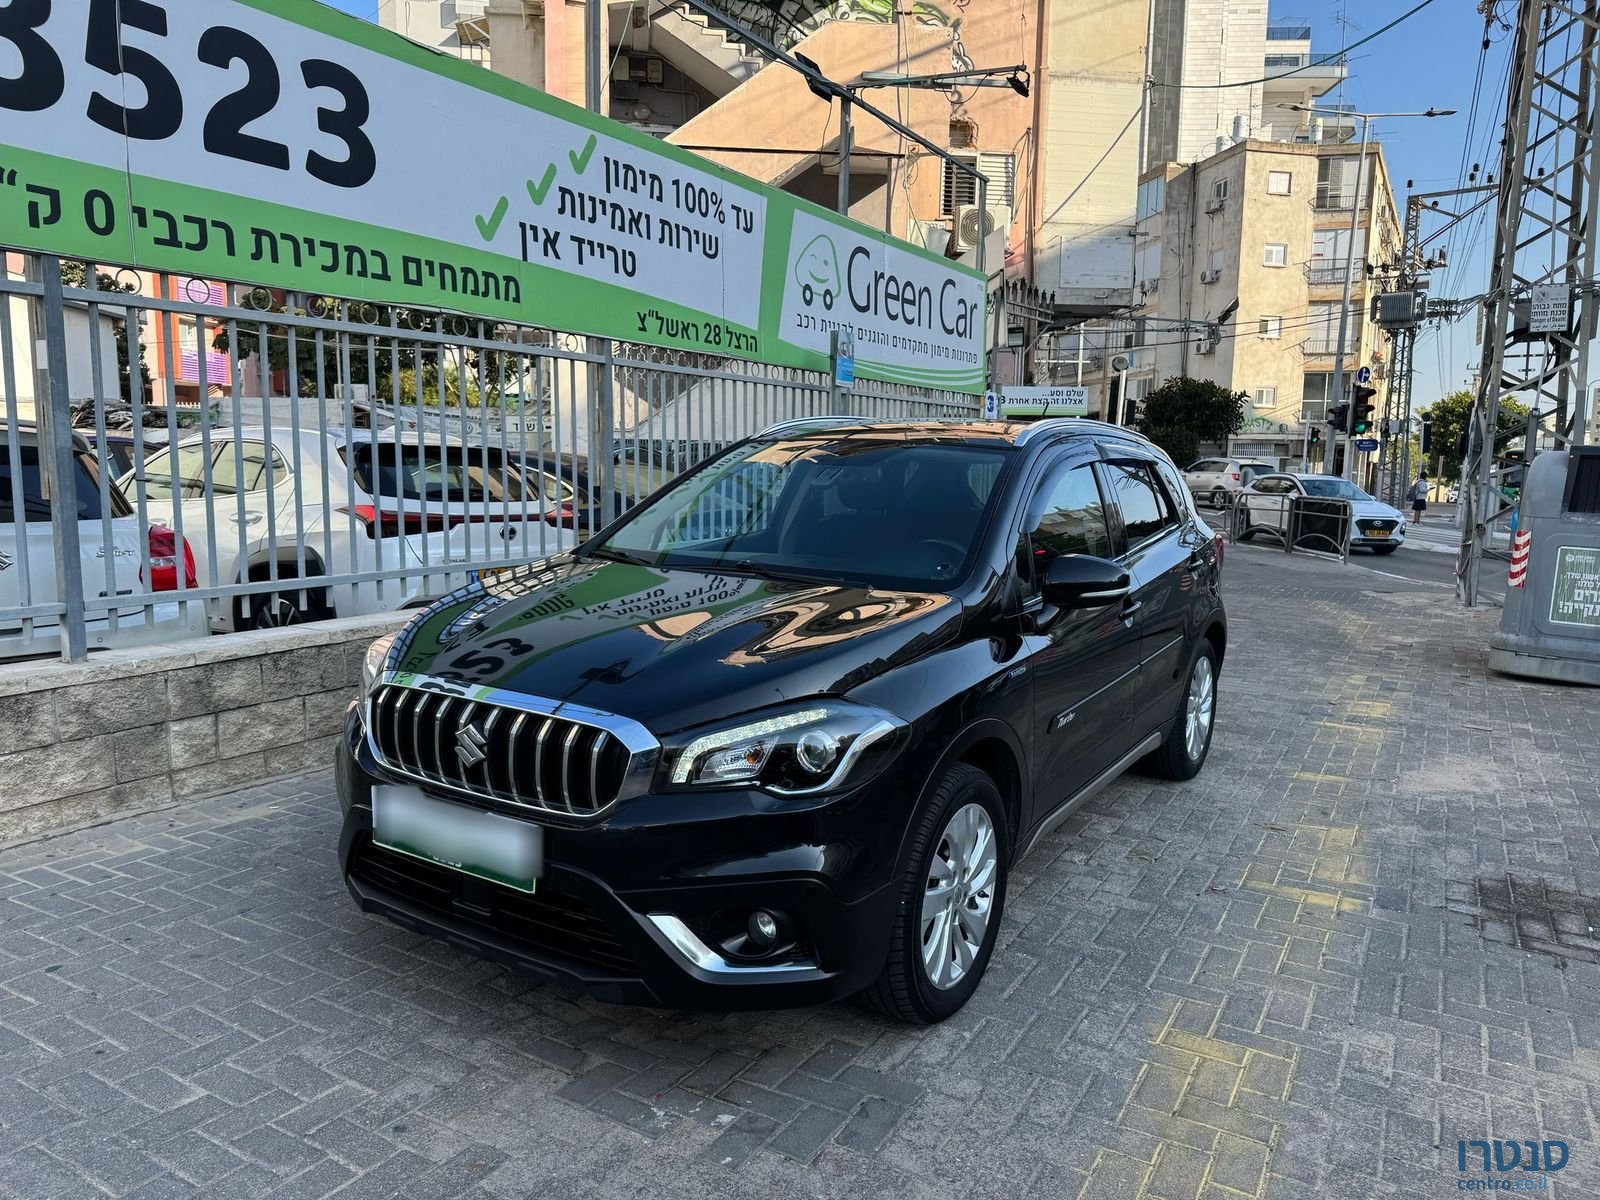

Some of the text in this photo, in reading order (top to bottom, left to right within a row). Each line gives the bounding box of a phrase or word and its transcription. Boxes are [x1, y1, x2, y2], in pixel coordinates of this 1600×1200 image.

[604, 156, 754, 234] עד 100% מימון
[132, 205, 236, 257] רכבי
[558, 186, 719, 259] שירות ואמינות
[250, 227, 391, 282] במכירת
[519, 221, 637, 277] טרייד אין
[402, 255, 521, 304] מתמחים
[847, 246, 978, 340] Green Car
[796, 313, 816, 331] רכב
[703, 322, 722, 345] 28
[725, 326, 758, 353] הרצל
[857, 327, 889, 346] והוגנים
[892, 335, 928, 354] מתקדמים
[930, 343, 950, 359] מימון
[951, 348, 977, 364] פתרונות
[1008, 397, 1030, 405] אחרת
[1061, 397, 1084, 405] אצלנו
[1066, 389, 1084, 397] שלם
[1574, 589, 1600, 603] רים
